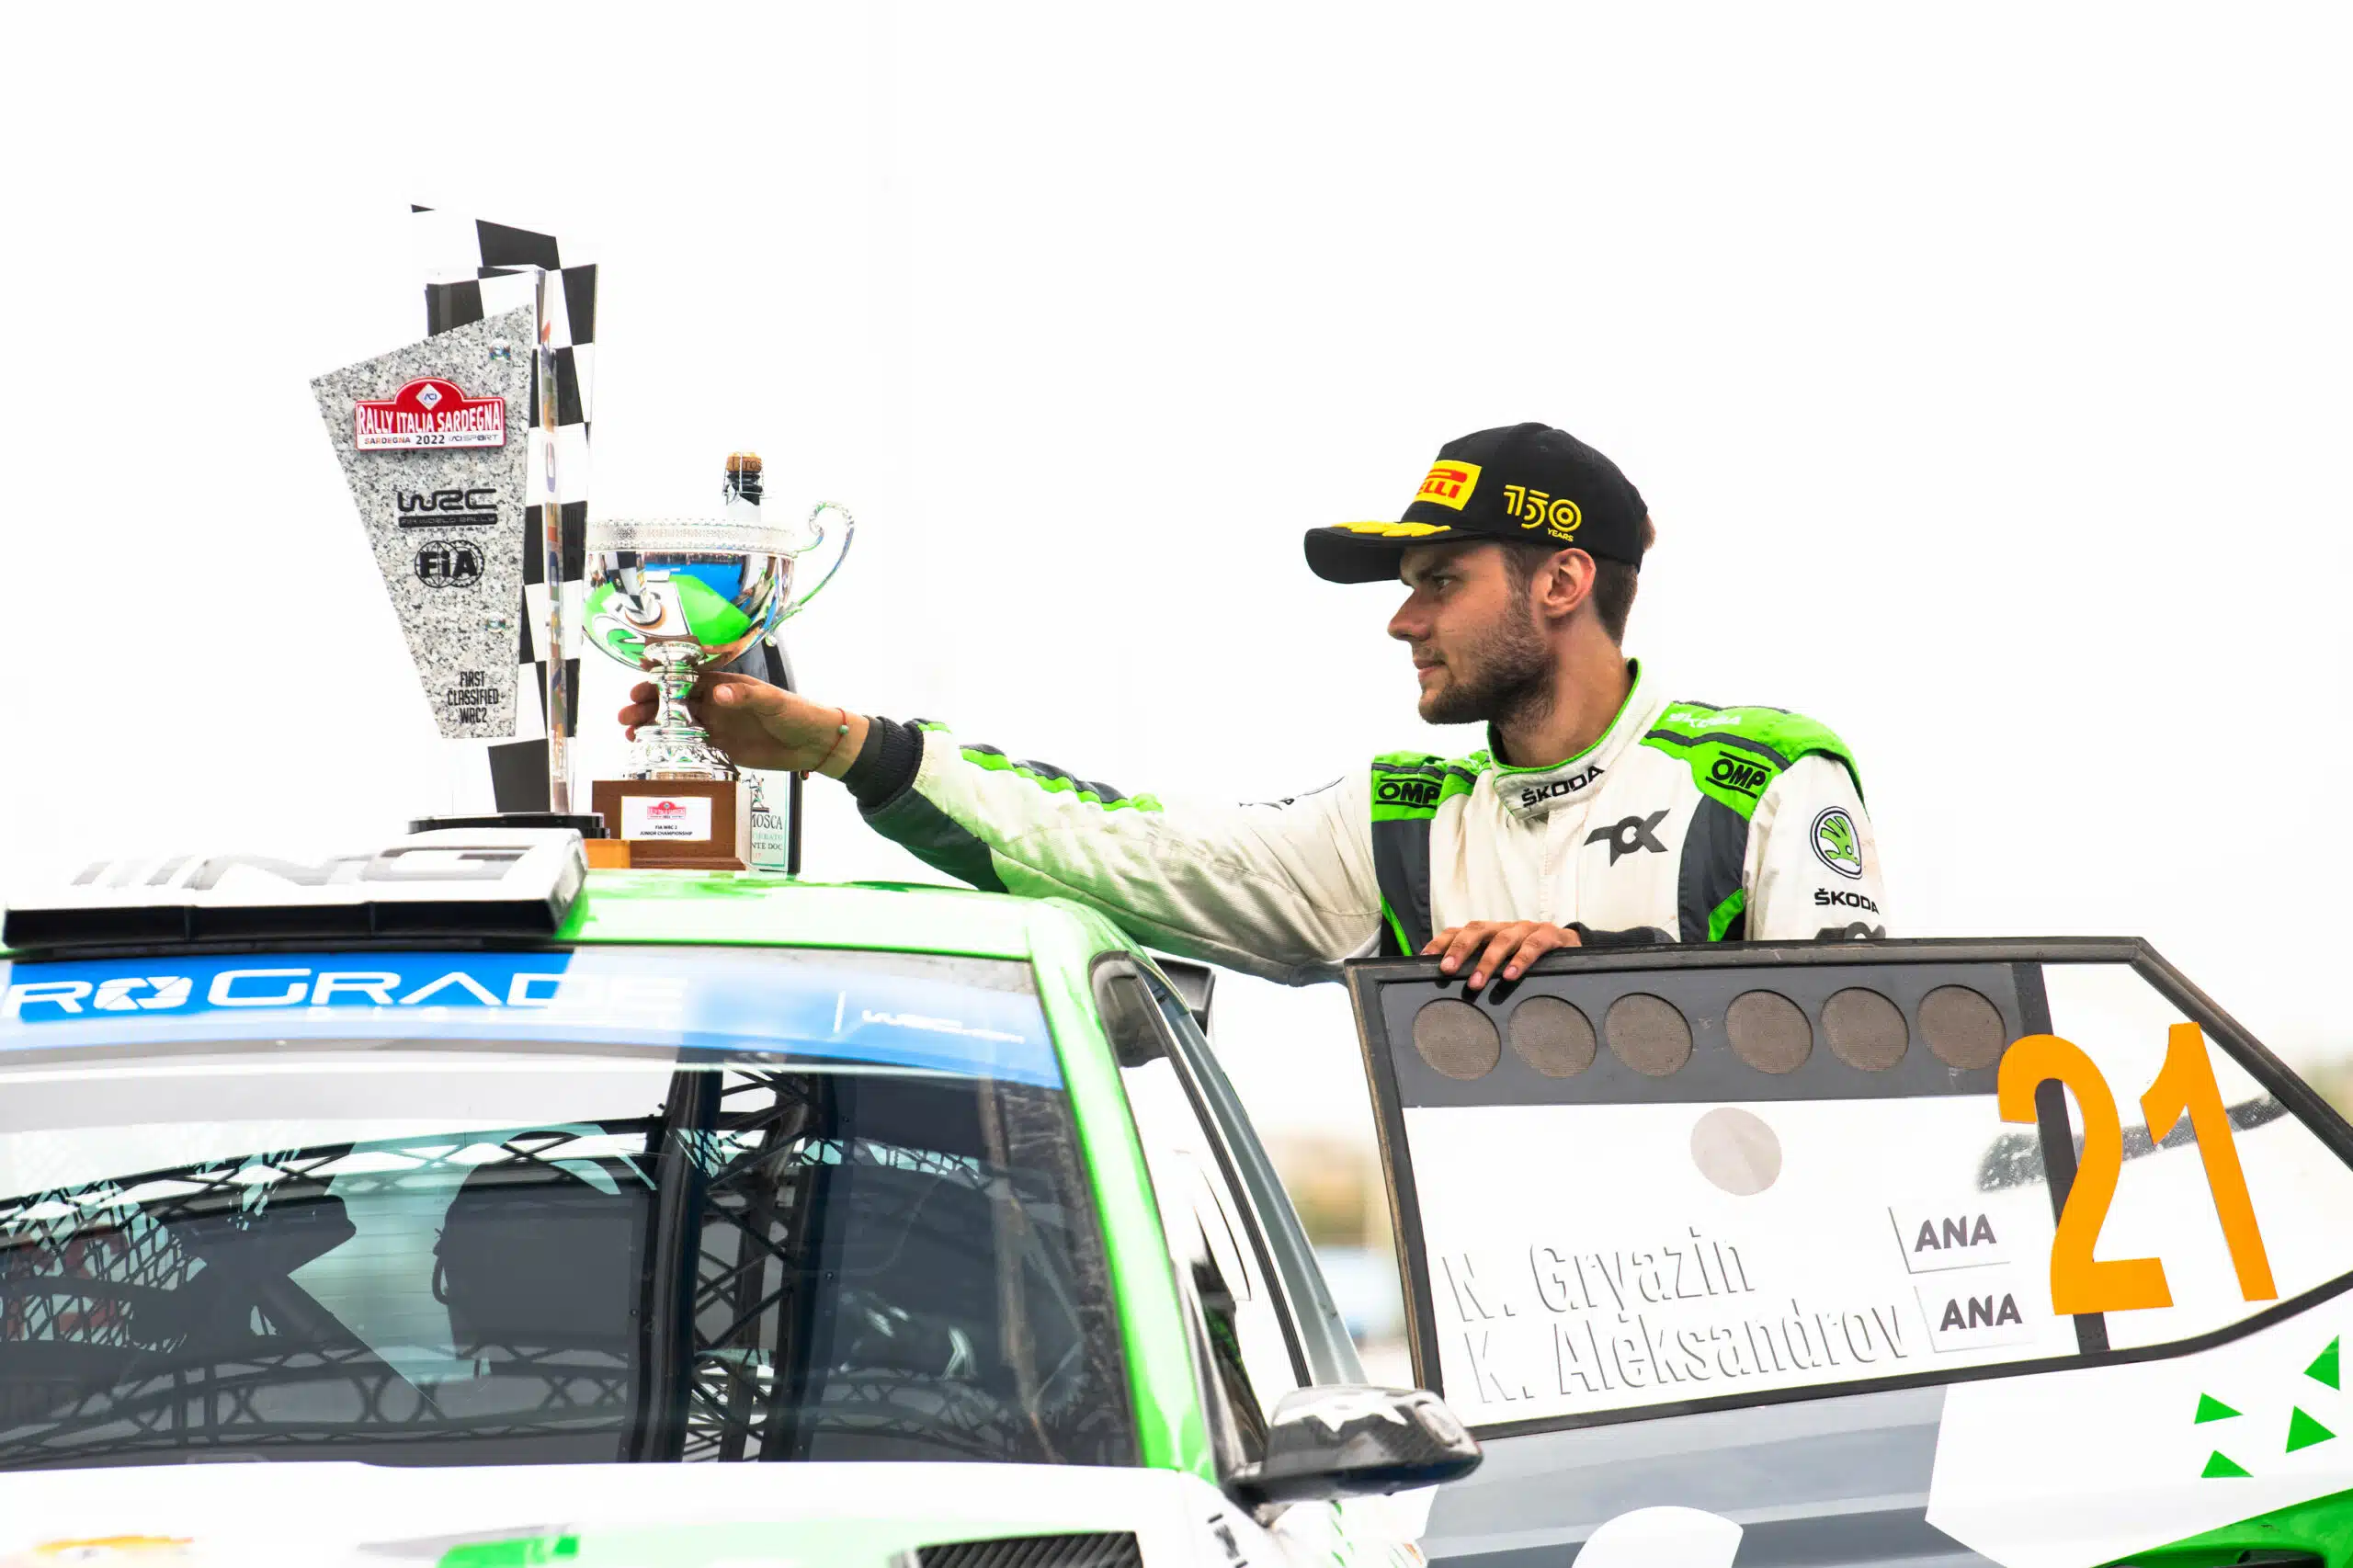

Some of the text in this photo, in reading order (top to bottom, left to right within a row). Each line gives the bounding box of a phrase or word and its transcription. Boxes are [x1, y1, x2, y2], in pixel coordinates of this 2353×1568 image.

[358, 402, 501, 435] RALLY ITALIA SARDEGNA
[364, 435, 446, 445] SARDEGNA 2022
[397, 488, 497, 512] WRC
[1503, 484, 1582, 532] 150
[1547, 528, 1574, 542] YEARS
[419, 551, 478, 578] FIA
[460, 670, 485, 687] FIRST
[447, 687, 499, 706] CLASSIFIED
[460, 707, 487, 724] WRC2
[1521, 765, 1606, 808] ŠKODA
[1711, 758, 1767, 790] OMP
[1379, 782, 1440, 805] OMP
[1813, 887, 1881, 916] ŠKODA
[1996, 1021, 2279, 1316] 21
[1914, 1213, 1997, 1253] ANA
[1529, 1226, 1756, 1324] Gryazin
[1939, 1293, 2023, 1332] ANA
[1553, 1298, 1909, 1395] Aleksandrov
